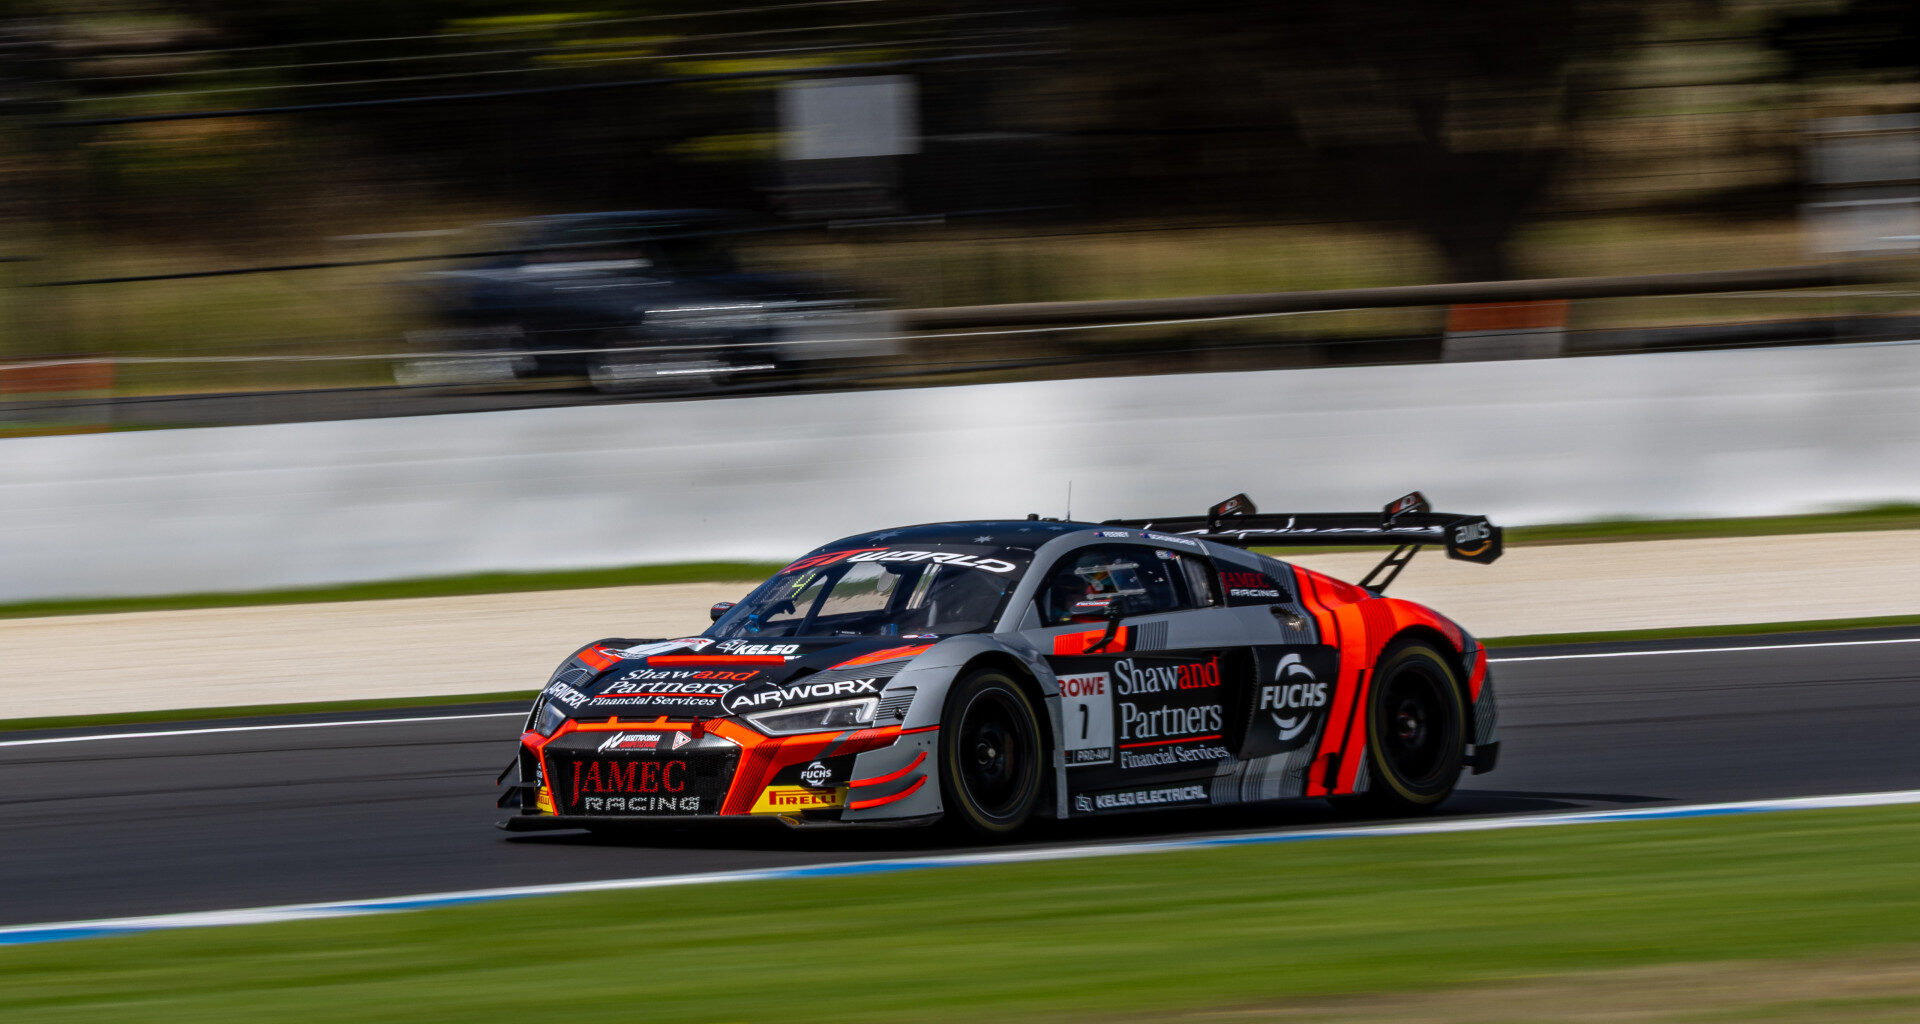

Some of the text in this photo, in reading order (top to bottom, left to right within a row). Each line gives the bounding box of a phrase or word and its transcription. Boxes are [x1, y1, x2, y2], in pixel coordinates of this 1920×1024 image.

[846, 551, 1016, 573] WORLD
[1230, 589, 1280, 597] RACING
[733, 644, 800, 655] KELSO
[600, 681, 734, 694] Partners
[731, 678, 878, 709] AIRWORX
[1260, 683, 1328, 710] FUCHS
[587, 696, 717, 706] Financial Services
[1079, 704, 1089, 739] 1
[1119, 702, 1223, 740] Partners
[1120, 745, 1231, 768] Financial Services
[571, 760, 686, 807] JAMEC
[801, 769, 832, 780] FUCHS
[584, 796, 700, 811] RACING
[769, 788, 837, 805] PIRELLI
[1096, 785, 1208, 808] KELSO ELECTRICAL
